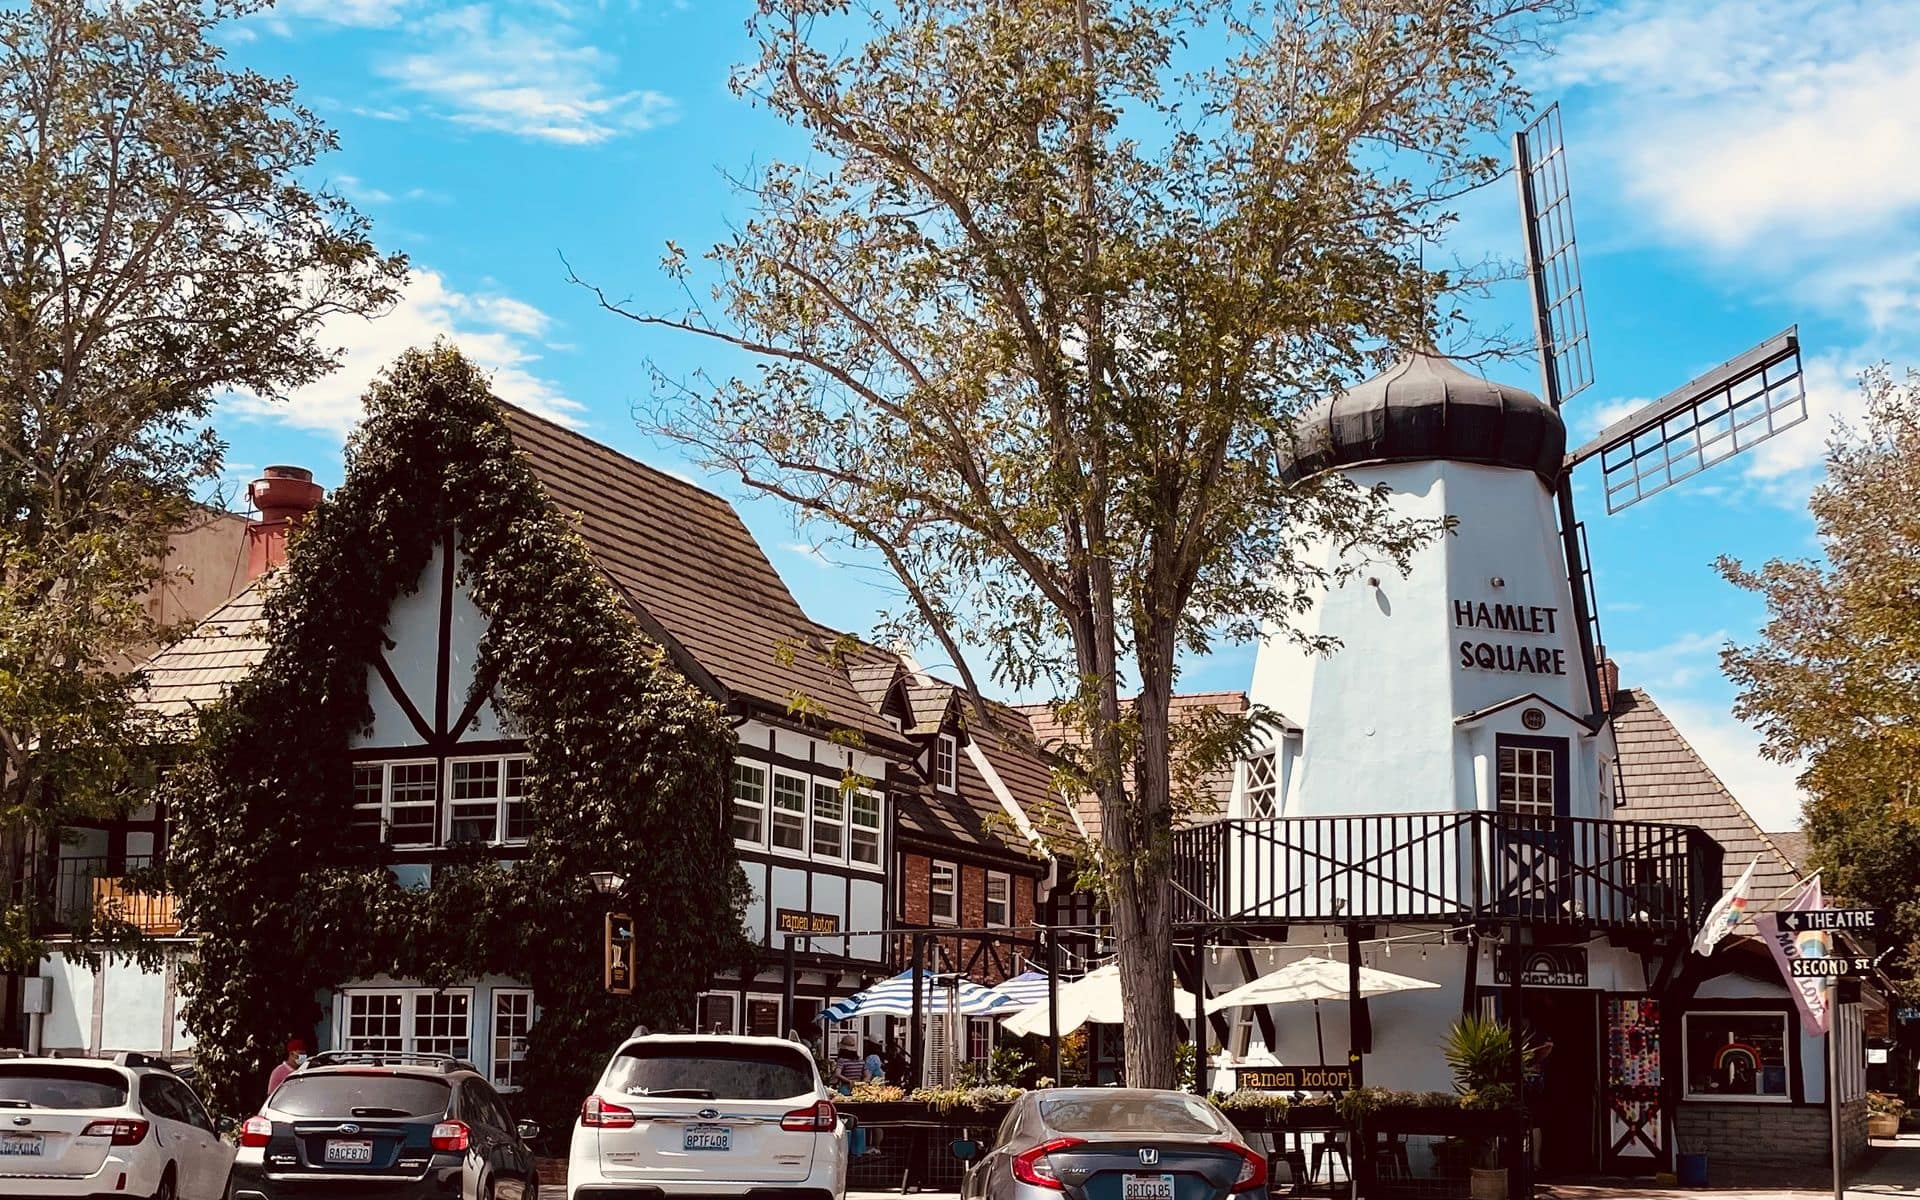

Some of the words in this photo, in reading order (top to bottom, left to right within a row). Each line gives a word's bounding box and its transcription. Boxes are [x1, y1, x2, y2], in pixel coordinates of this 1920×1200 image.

[1454, 600, 1557, 633] HAMLET
[1460, 641, 1566, 675] SQUARE
[781, 914, 808, 930] ramen
[1805, 911, 1875, 928] THEATRE
[1793, 960, 1848, 975] SECOND
[1242, 1072, 1295, 1087] ramen
[1301, 1068, 1354, 1090] kotori
[687, 1135, 728, 1147] 8PTF408
[329, 1147, 369, 1160] 8ACF870
[1127, 1184, 1171, 1197] 8RTG185
